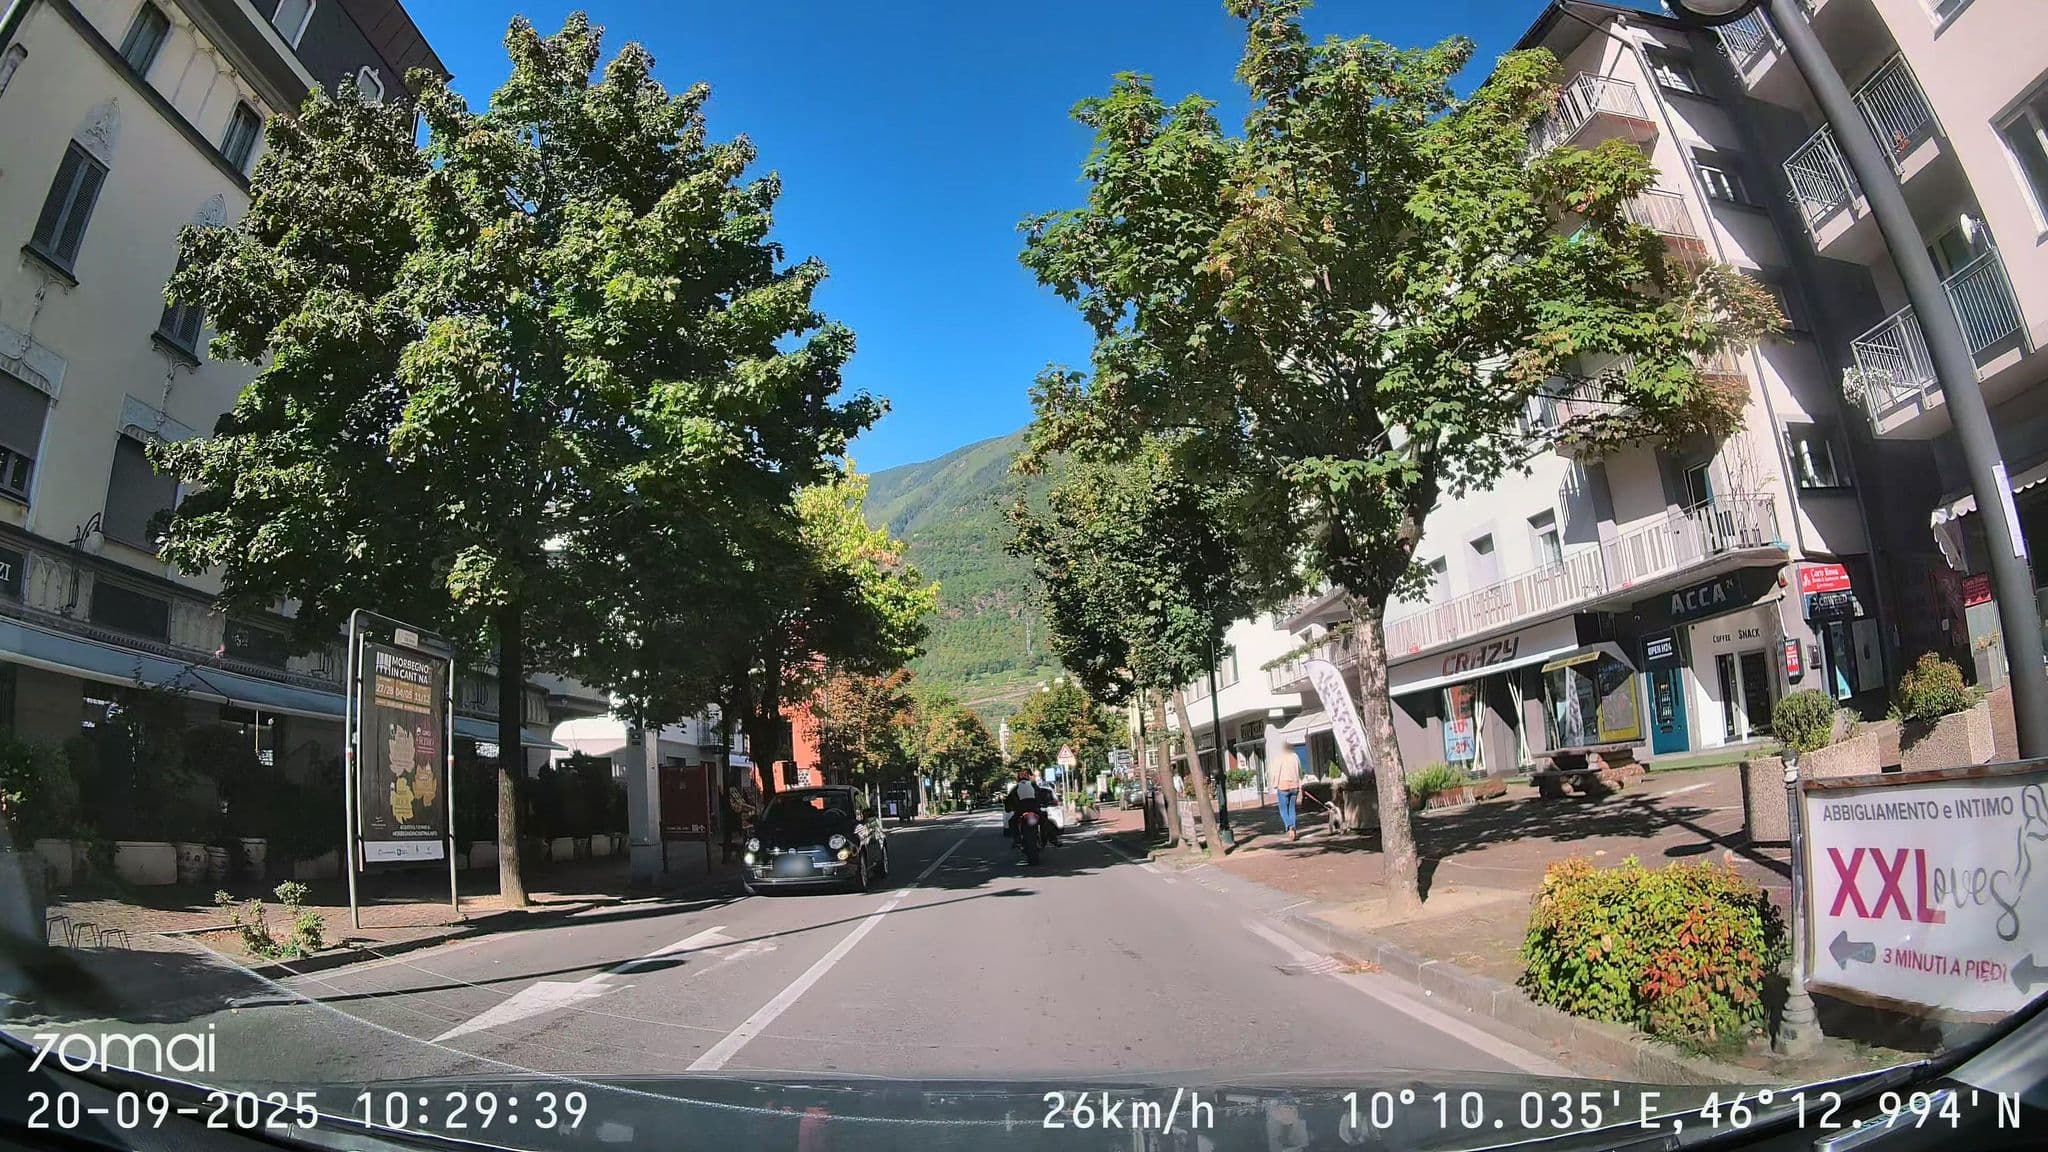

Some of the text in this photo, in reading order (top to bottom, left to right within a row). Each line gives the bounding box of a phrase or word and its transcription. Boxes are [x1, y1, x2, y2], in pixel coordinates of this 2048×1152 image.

[1671, 583, 1726, 615] ACCA
[1738, 628, 1760, 640] SNACK
[391, 666, 399, 677] IN
[400, 669, 428, 685] CANTNA
[392, 655, 429, 674] MORBEGNO
[1823, 796, 2014, 821] ABBIGLIAMENTO e INTIMO
[1883, 948, 1891, 964] 3
[1896, 949, 1947, 976] MINUTI
[1950, 958, 1961, 976] A
